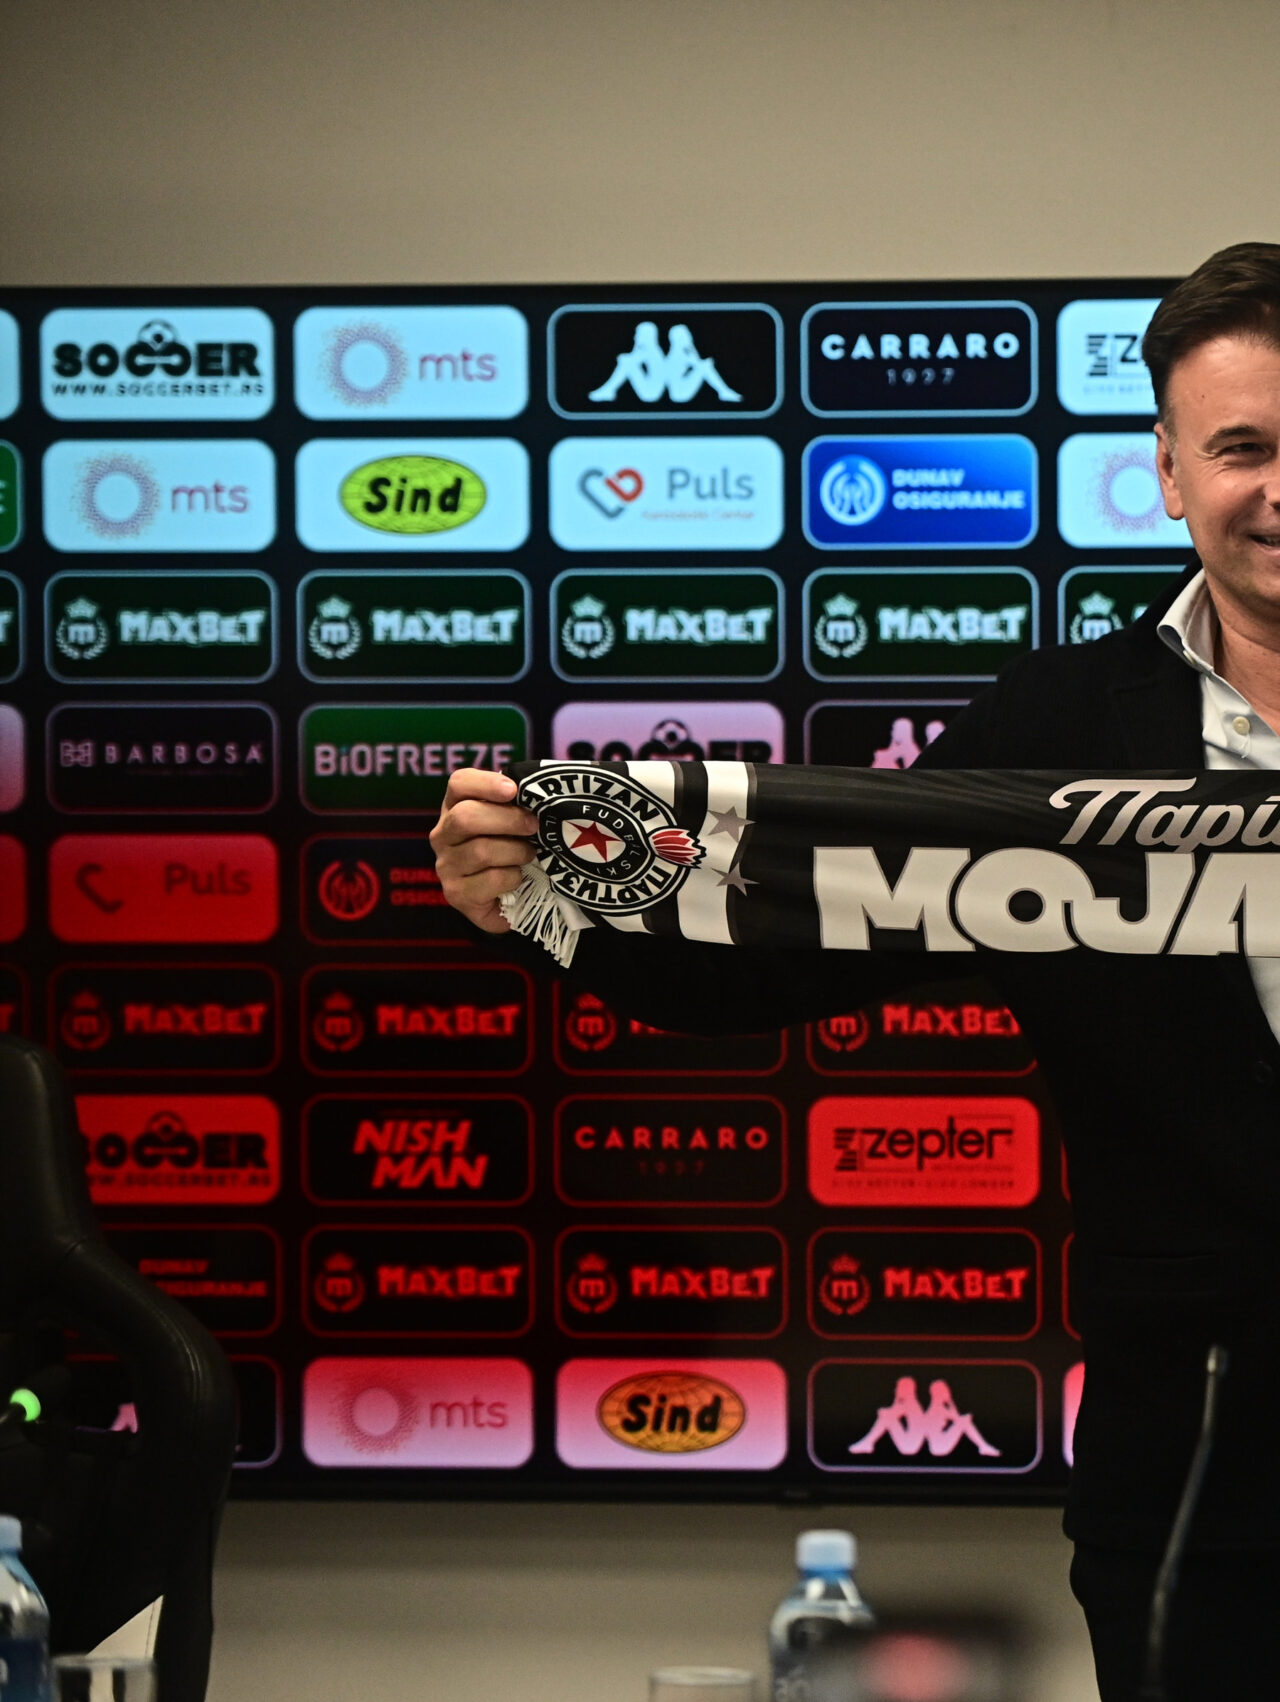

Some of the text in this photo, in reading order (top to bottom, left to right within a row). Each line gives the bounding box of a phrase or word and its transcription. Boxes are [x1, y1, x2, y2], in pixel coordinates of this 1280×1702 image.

[54, 342, 261, 378] SOCCER
[821, 333, 1019, 360] CARRARO
[419, 350, 497, 381] mts
[54, 384, 262, 395] WWW.SOCCERBET.RS
[668, 468, 754, 500] Puls
[892, 468, 965, 487] DUNAV
[171, 482, 248, 513] mts
[363, 477, 462, 514] Sind
[892, 490, 1026, 510] OSIGURANJE
[106, 743, 261, 763] BARBOSA
[522, 774, 660, 821] ARTIZAN
[163, 862, 251, 896] Puls
[85, 1134, 268, 1169] OCCER
[353, 1120, 471, 1154] NISH
[576, 1126, 768, 1149] CARRARO
[860, 1116, 1013, 1171] zepter
[371, 1156, 488, 1189] MAN
[430, 1396, 508, 1428] mts
[621, 1393, 722, 1433] Sind
